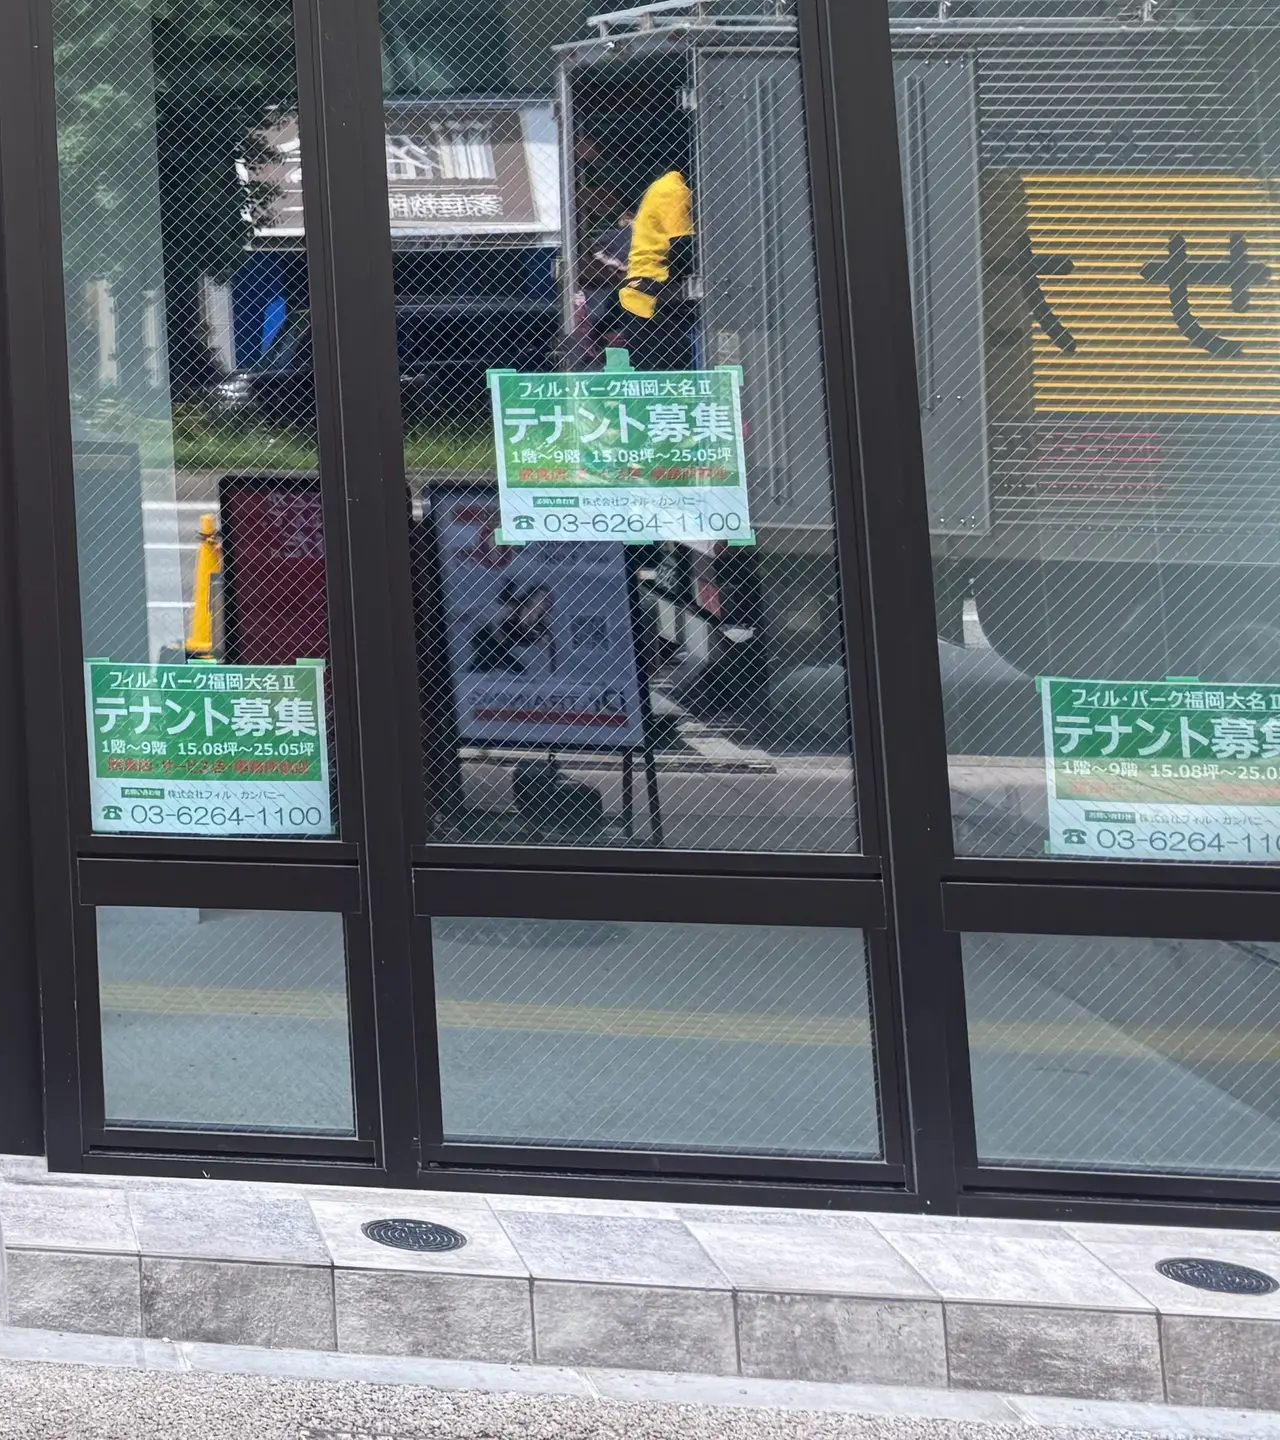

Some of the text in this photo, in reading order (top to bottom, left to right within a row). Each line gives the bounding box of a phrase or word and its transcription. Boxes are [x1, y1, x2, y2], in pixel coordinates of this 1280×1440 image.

[504, 402, 734, 445] テナント募集
[544, 513, 741, 534] 03-6264-1100
[95, 696, 317, 737] テナント募集
[131, 805, 321, 826] 03-6264-1100
[1097, 828, 1280, 853] 03-6264-11
